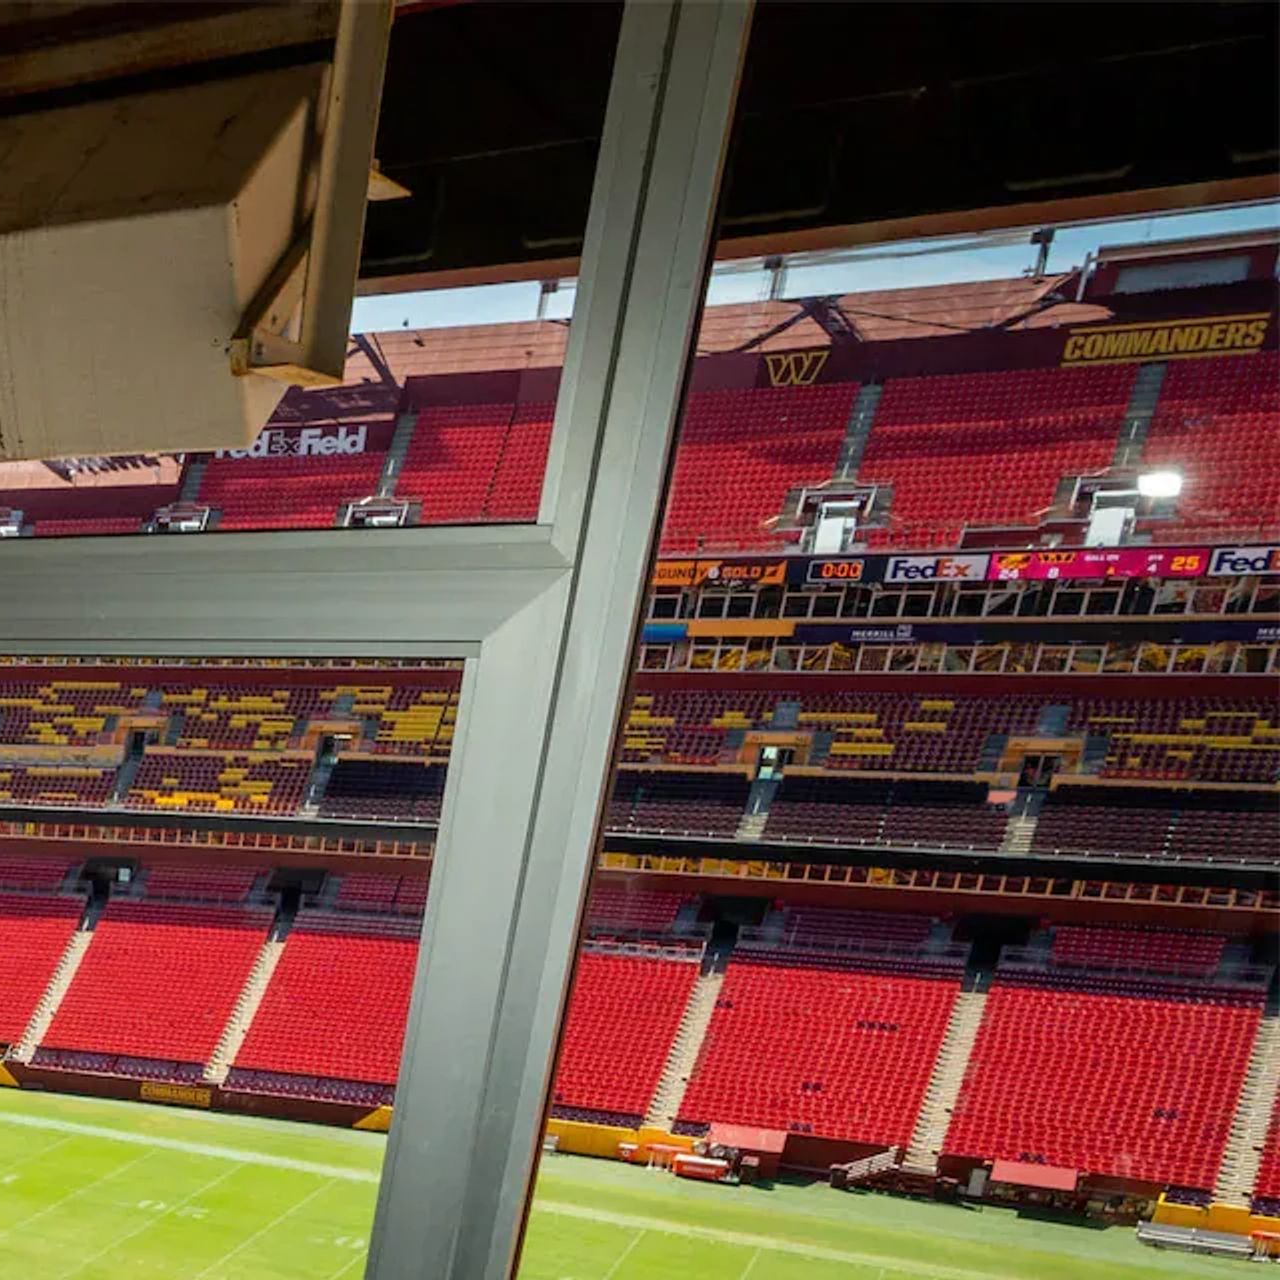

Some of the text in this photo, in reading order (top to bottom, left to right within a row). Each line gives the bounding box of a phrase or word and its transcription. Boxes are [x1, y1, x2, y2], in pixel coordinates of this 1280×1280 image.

[1063, 321, 1268, 360] COMMANDERS
[891, 559, 972, 578] FedEx
[1170, 555, 1200, 571] 25
